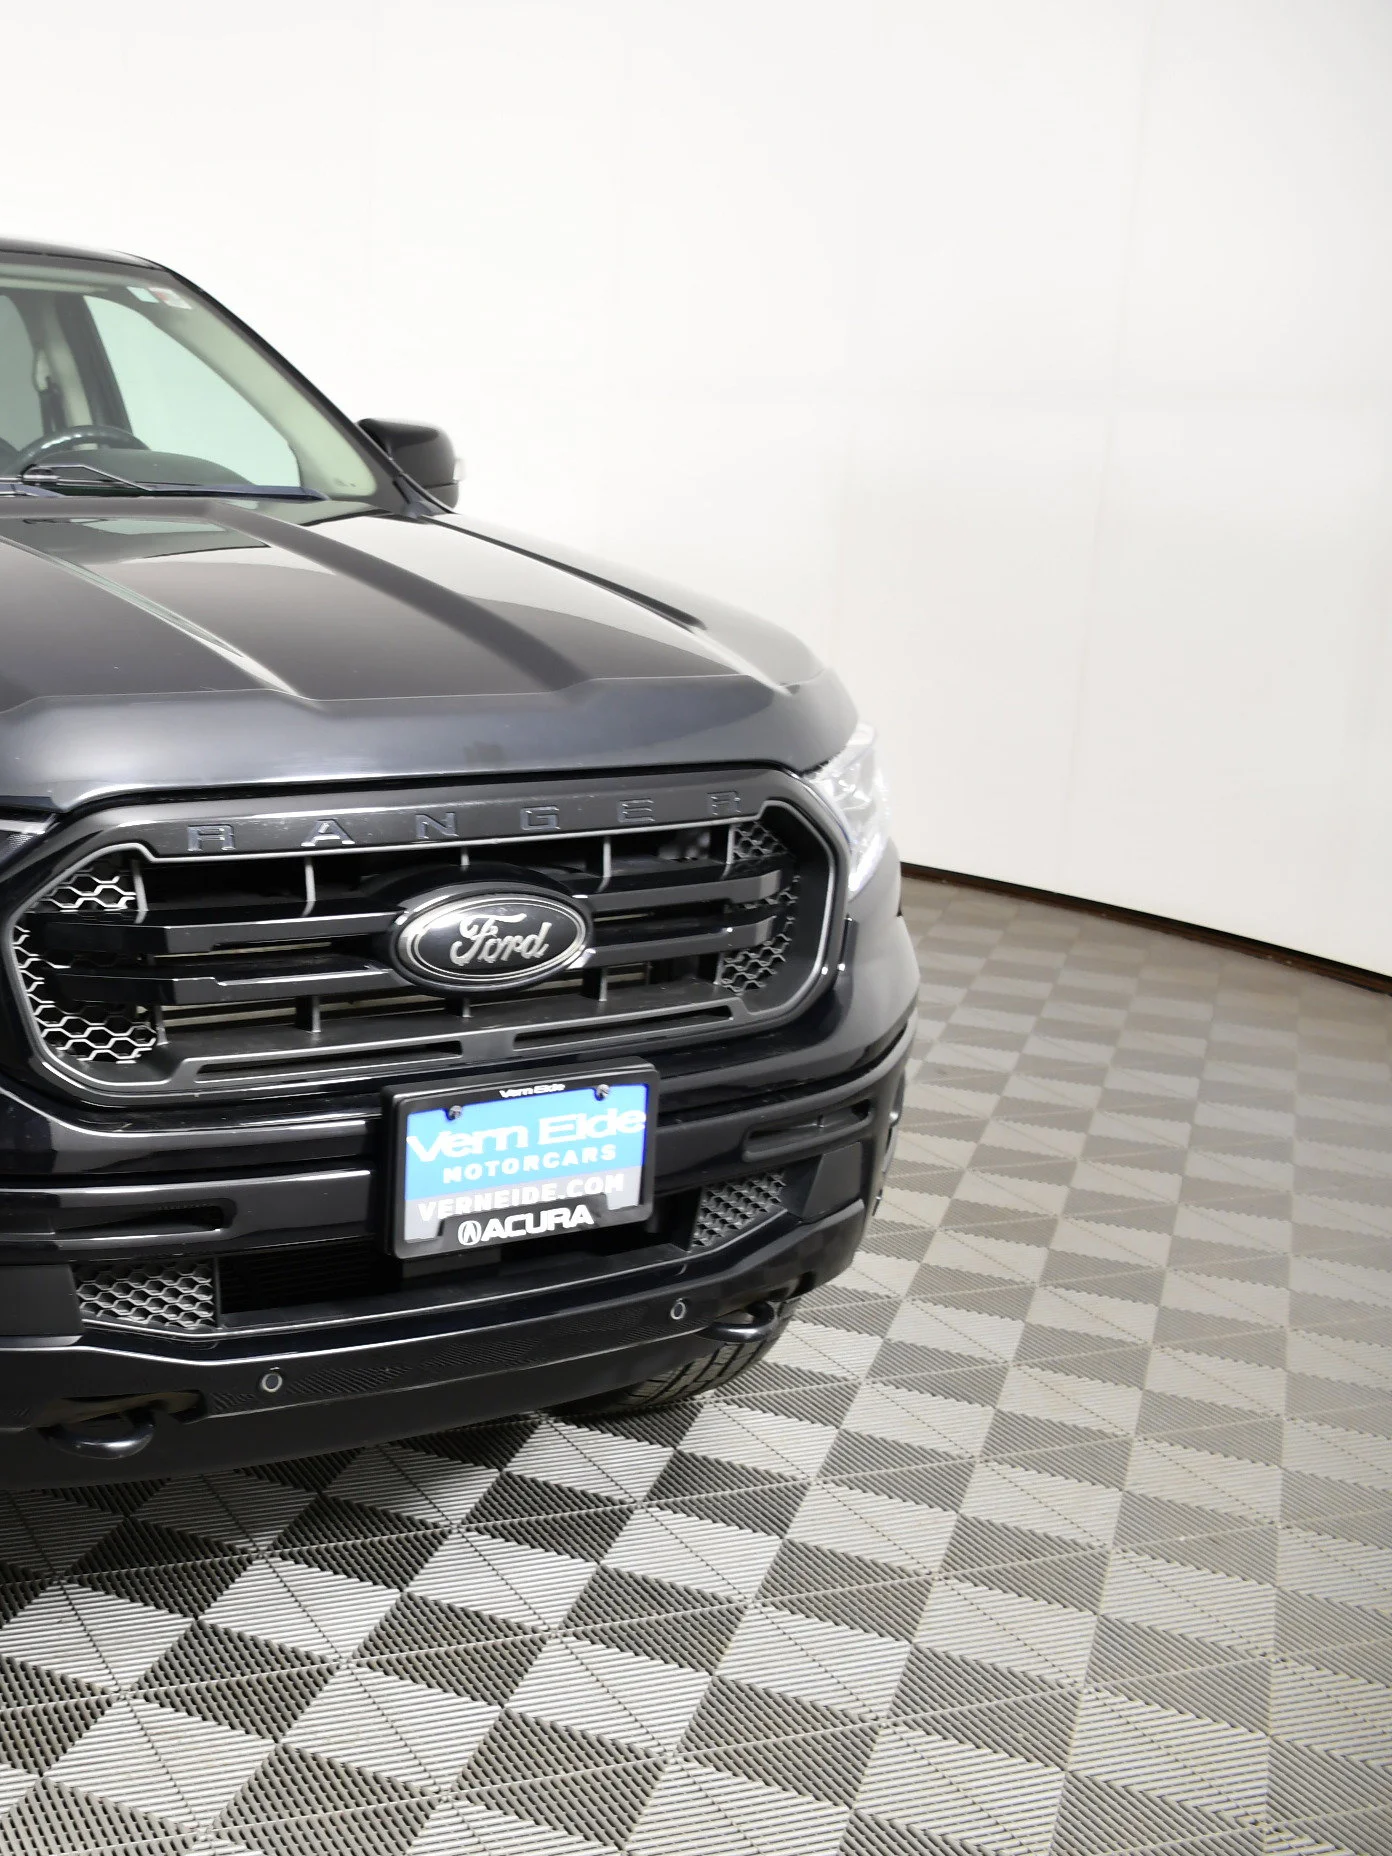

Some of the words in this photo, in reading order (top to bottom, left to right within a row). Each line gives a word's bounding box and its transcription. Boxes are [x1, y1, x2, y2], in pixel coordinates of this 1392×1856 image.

[187, 790, 742, 852] RANGER
[451, 914, 550, 965] Ford
[499, 1086, 533, 1098] Vern
[532, 1083, 566, 1094] Eide
[407, 1125, 528, 1162] Vern
[538, 1109, 646, 1144] Eide
[442, 1145, 616, 1183] MOTORCARS
[418, 1174, 624, 1222] VERNEIDE.COM
[481, 1204, 594, 1241] ACURA
